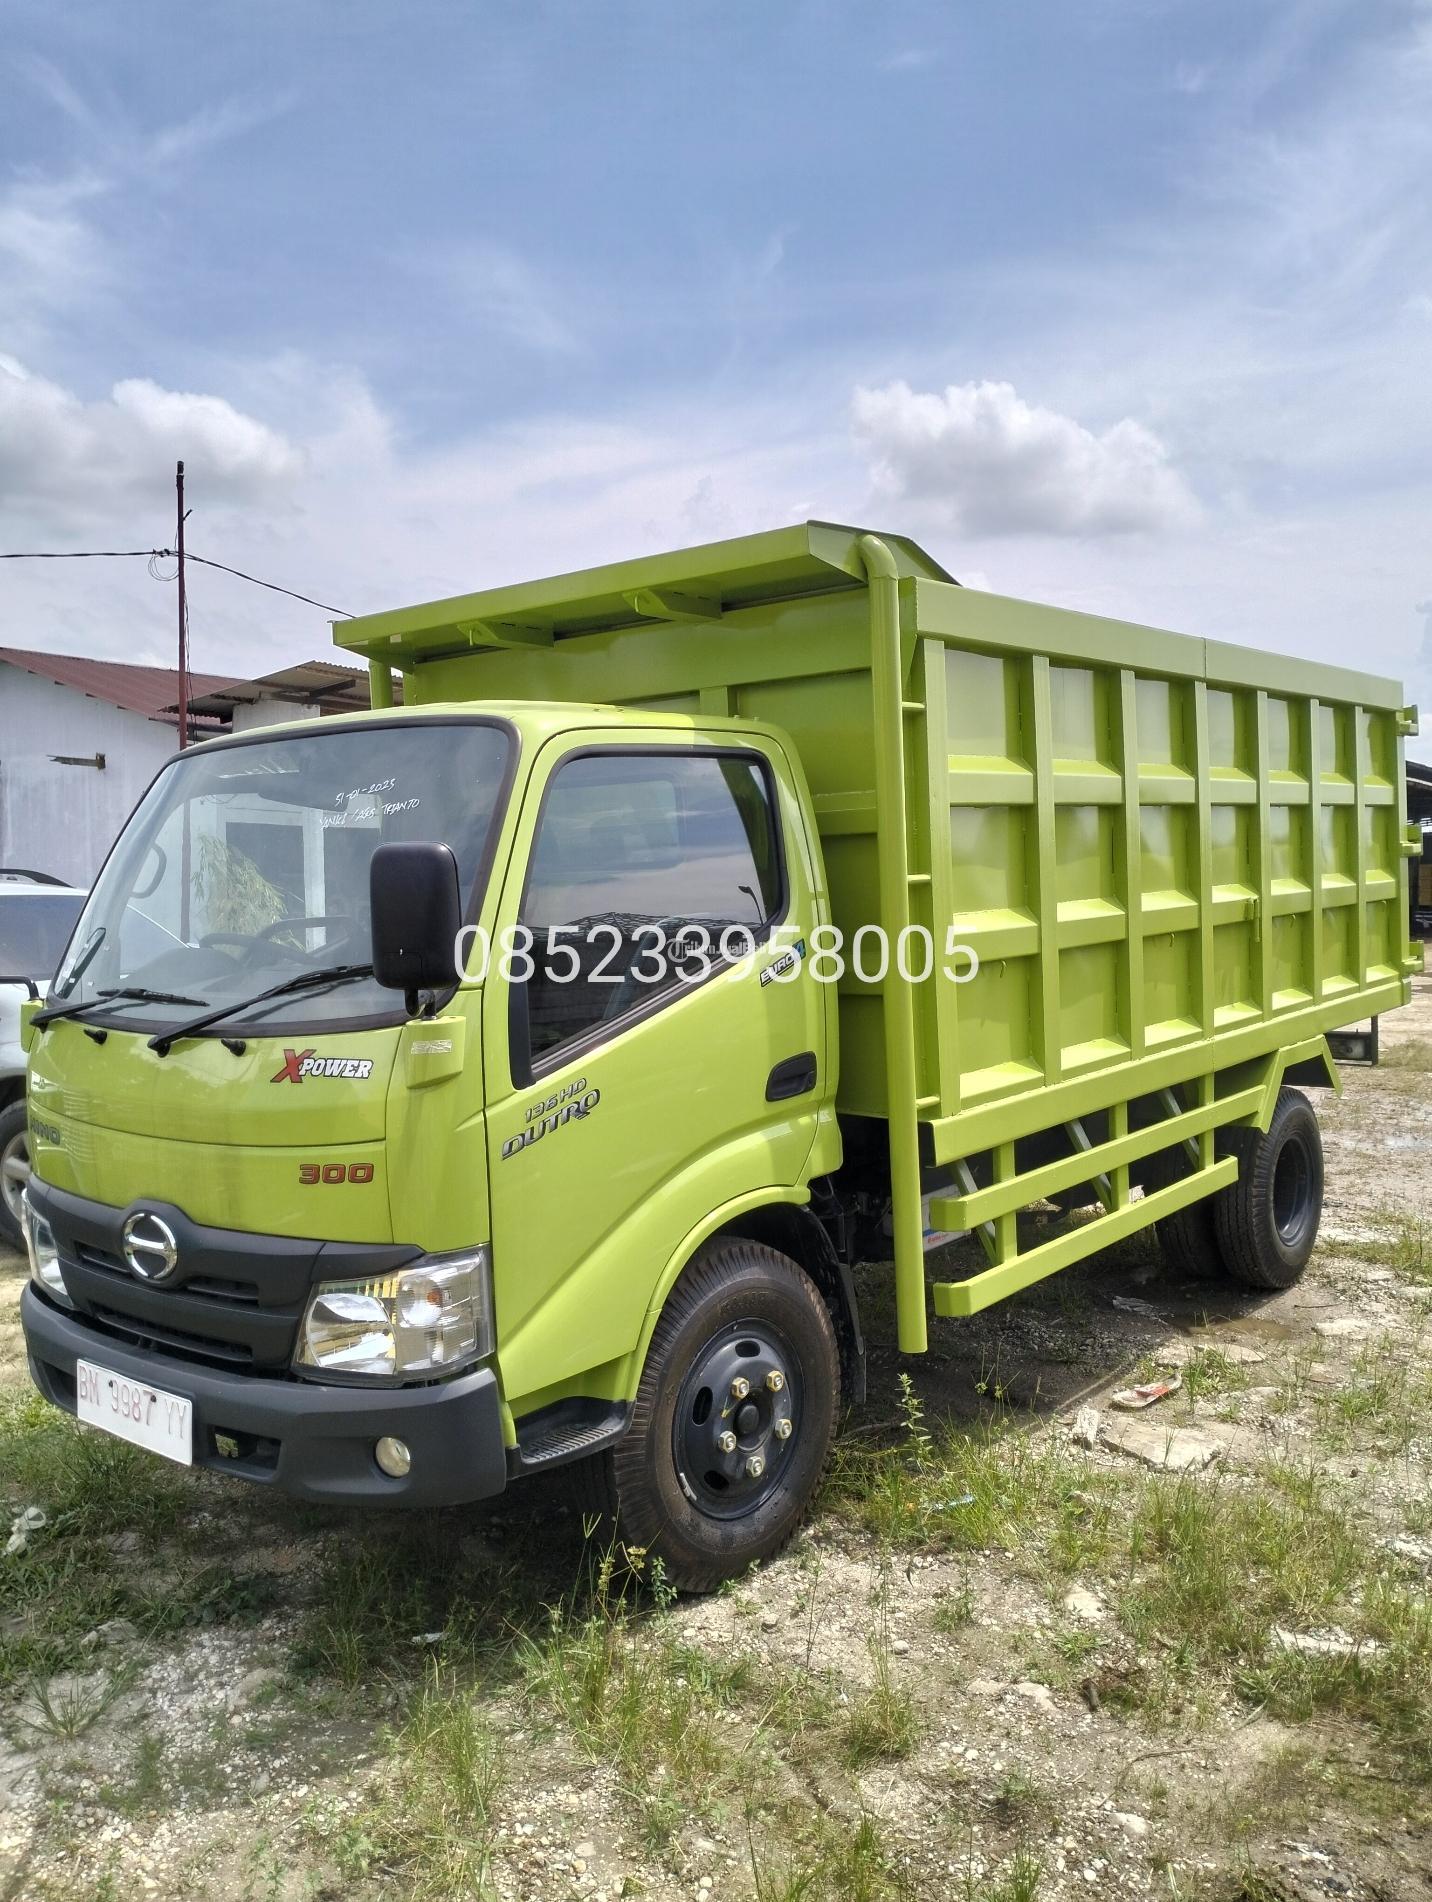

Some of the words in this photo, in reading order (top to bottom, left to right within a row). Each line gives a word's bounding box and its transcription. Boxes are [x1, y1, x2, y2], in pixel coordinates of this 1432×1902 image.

[761, 953, 795, 984] EURO
[525, 1094, 559, 1124] 136
[559, 1077, 587, 1105] HD
[501, 1088, 601, 1161] DUTRO
[299, 1163, 375, 1185] 300
[79, 1365, 101, 1407] BM
[164, 1397, 188, 1440] YY
